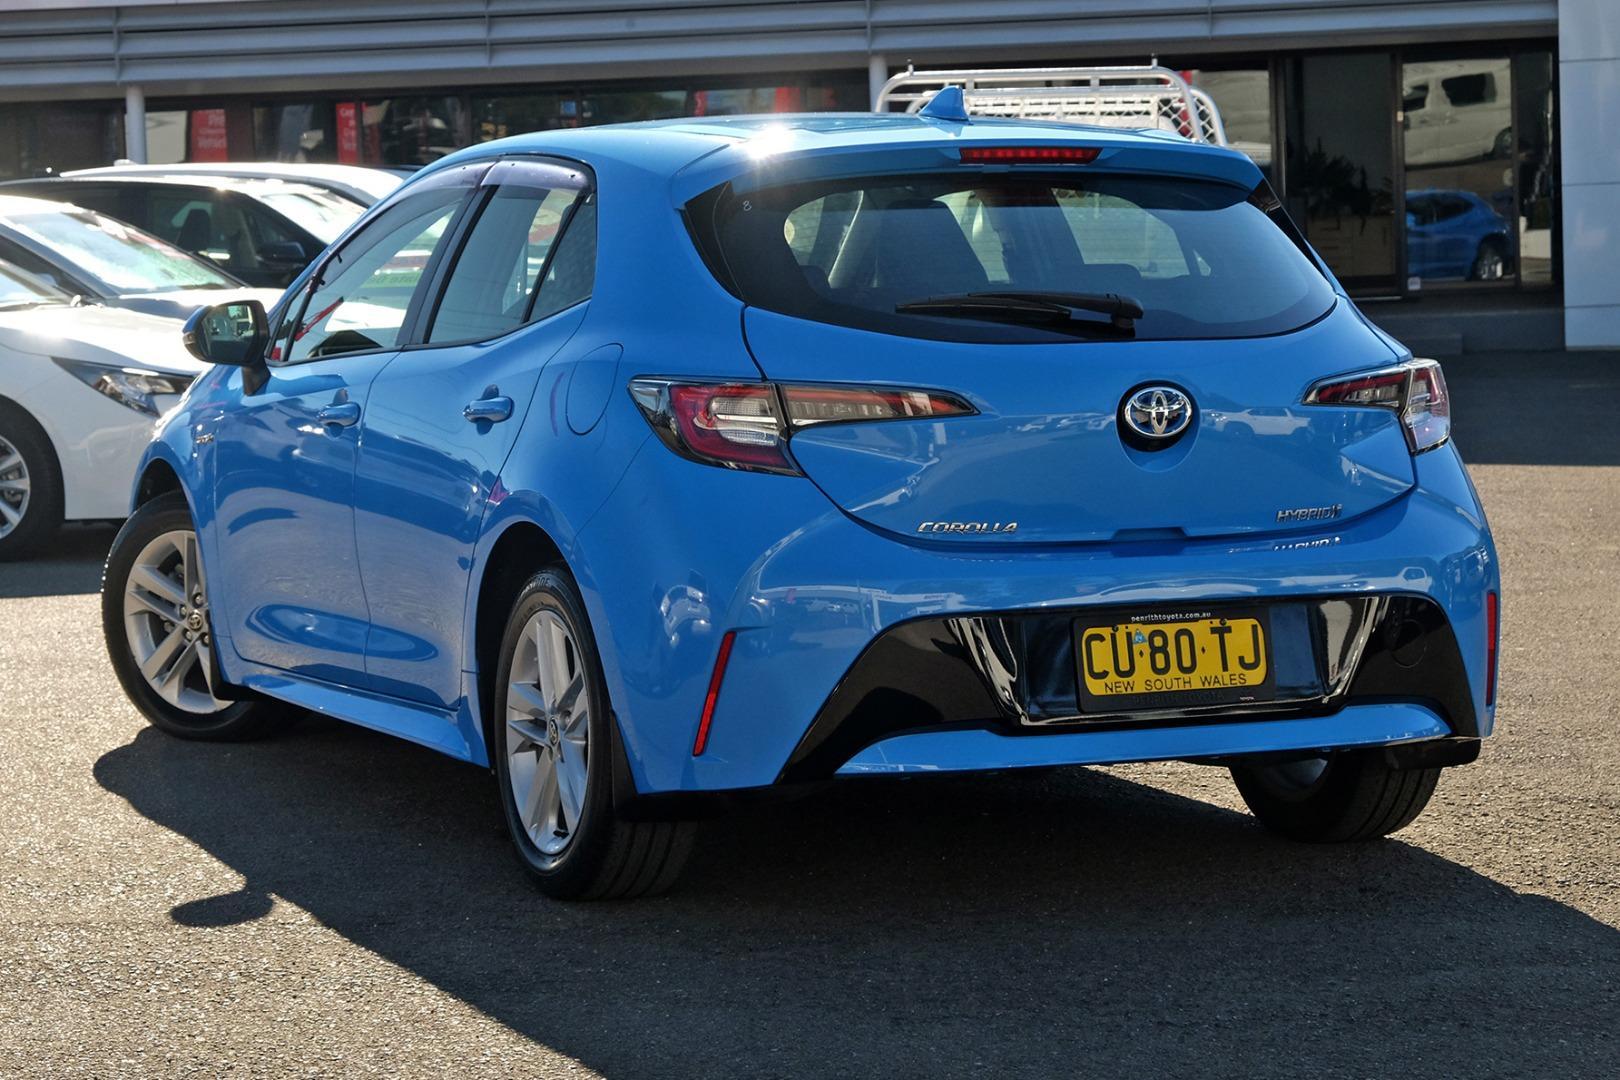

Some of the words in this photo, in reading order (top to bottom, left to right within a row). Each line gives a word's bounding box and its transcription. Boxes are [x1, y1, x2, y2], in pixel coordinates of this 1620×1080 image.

[917, 521, 1018, 534] COROLLA
[1130, 612, 1212, 623] penrithtoyota.com.au
[1103, 680, 1136, 694] NEW
[1144, 676, 1192, 692] SOUTH
[1199, 672, 1248, 688] WALES
